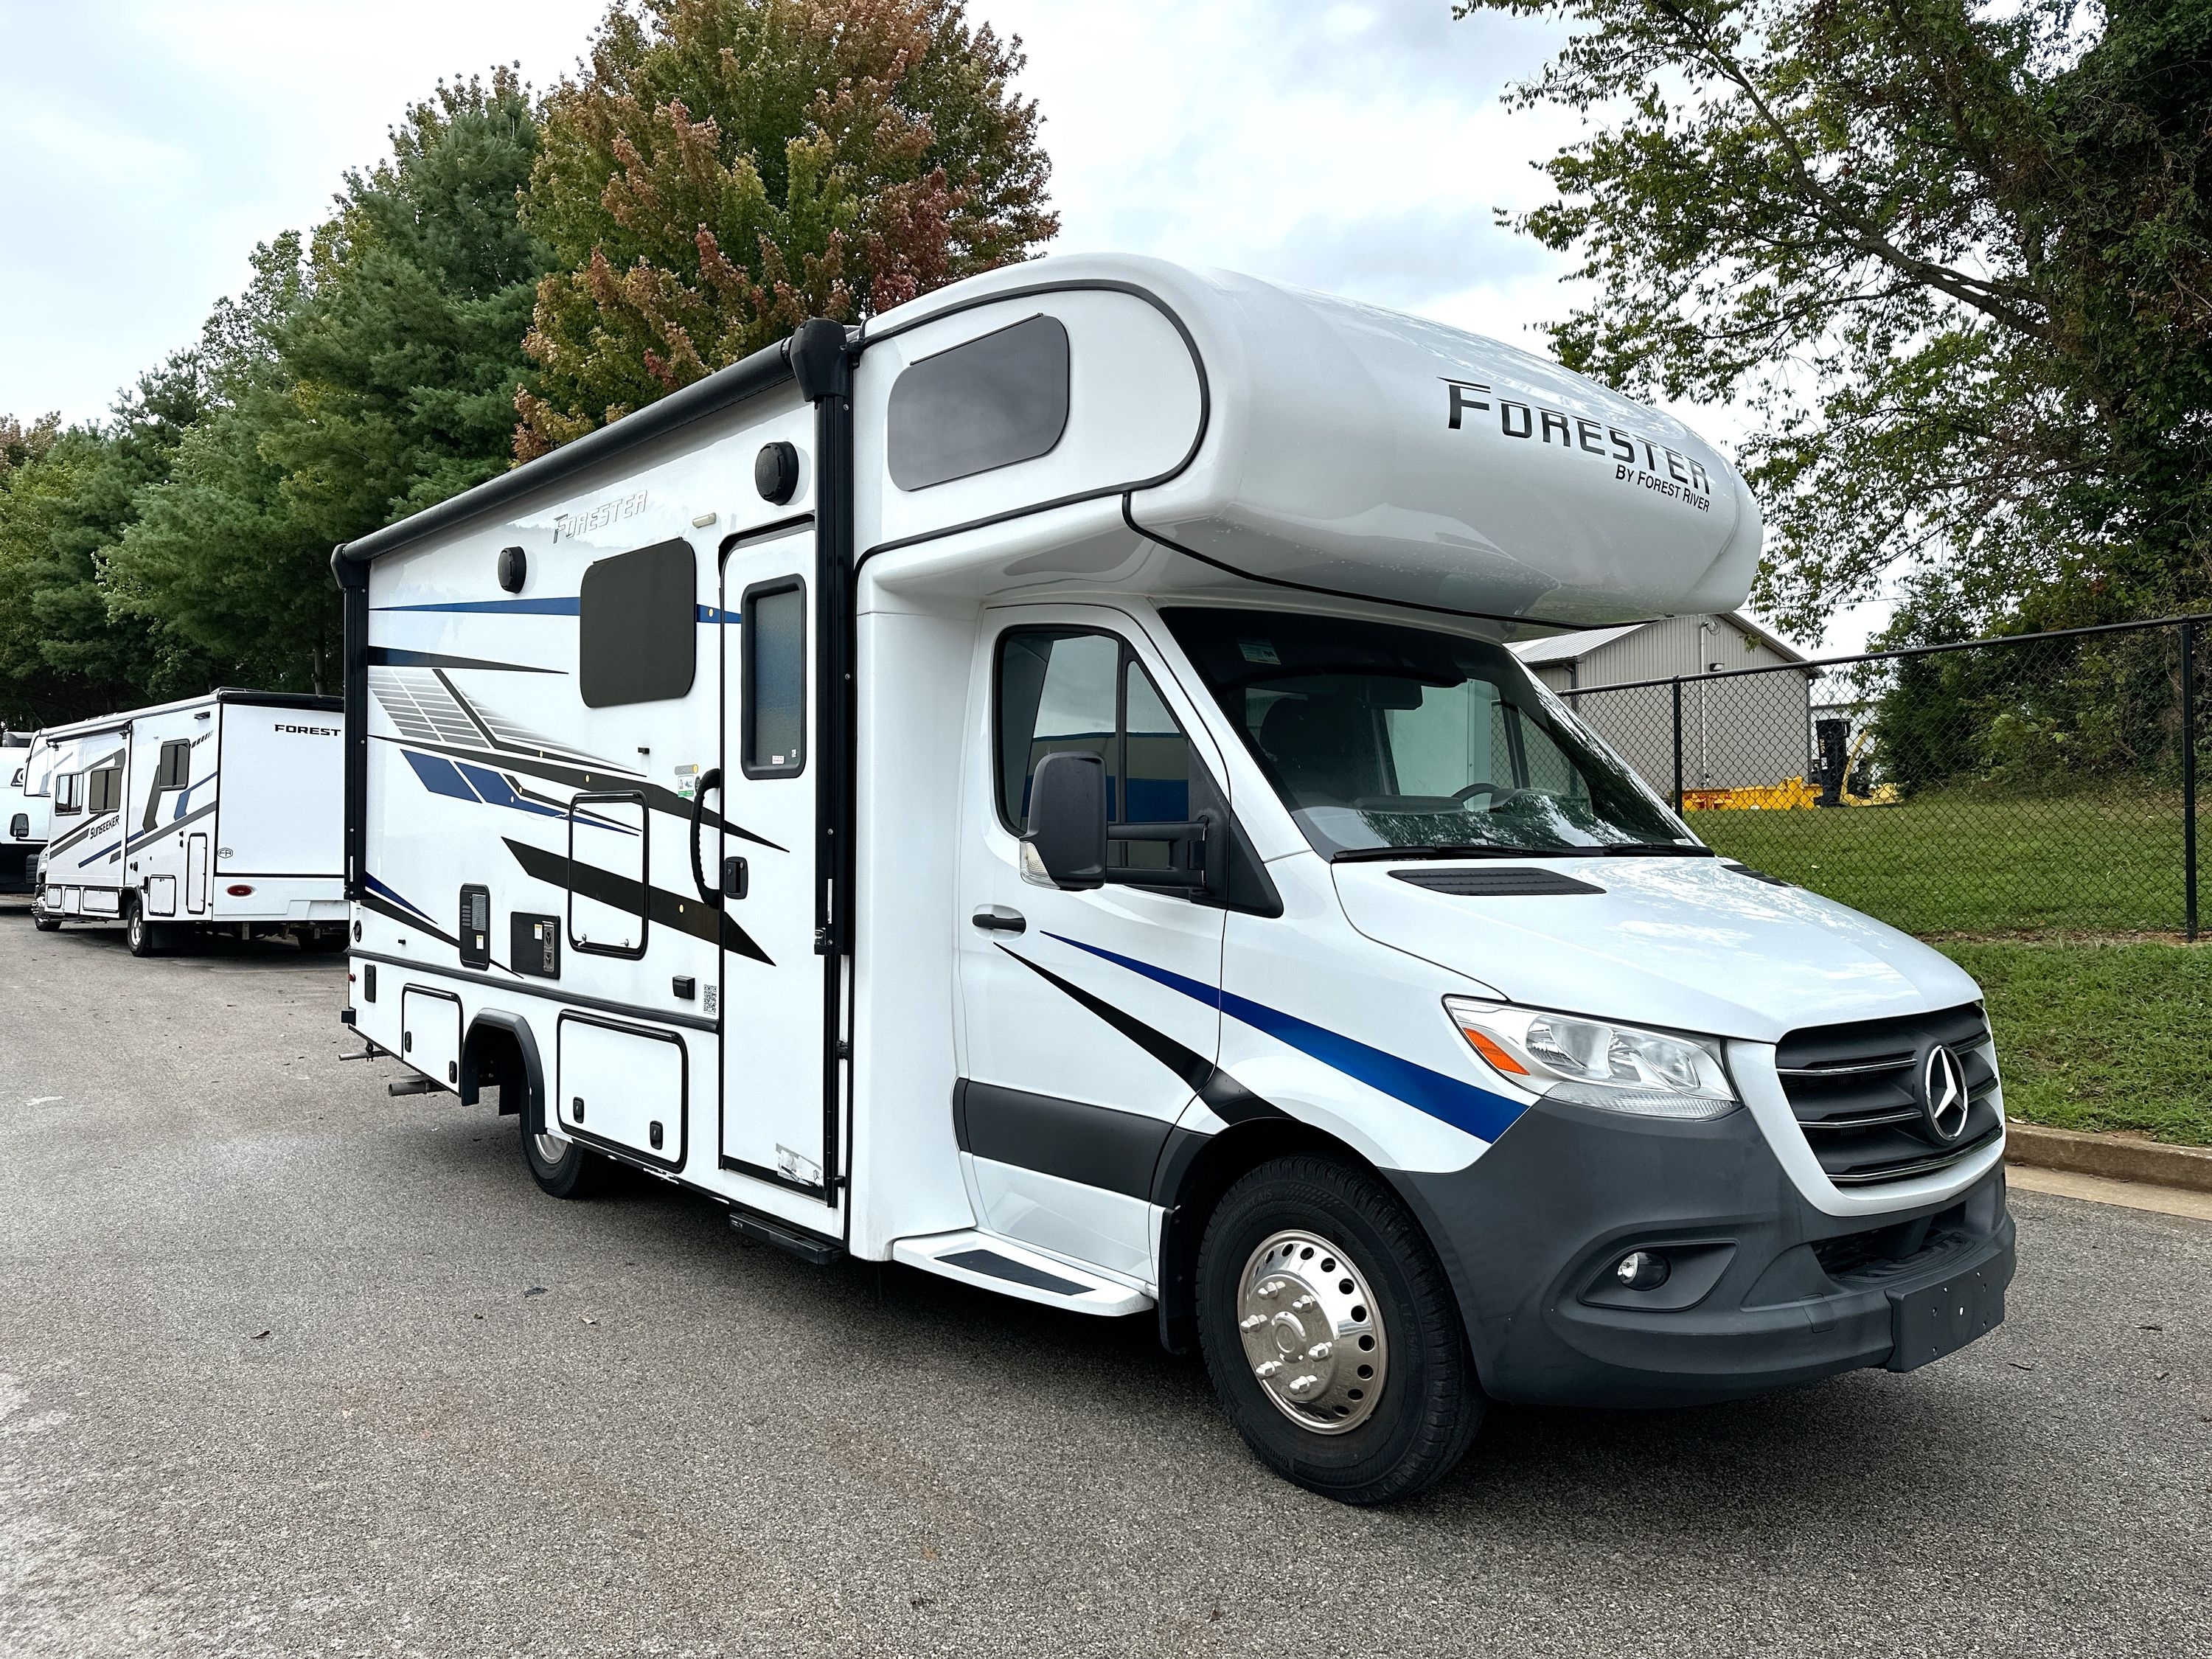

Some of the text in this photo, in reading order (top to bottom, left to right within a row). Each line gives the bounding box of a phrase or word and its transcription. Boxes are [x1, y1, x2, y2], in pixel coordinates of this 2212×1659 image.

[1437, 377, 1711, 495] FORESTER
[1615, 464, 1710, 512] BY FOREST RIVER
[553, 490, 647, 543] FORESTER
[274, 724, 341, 737] FOREST
